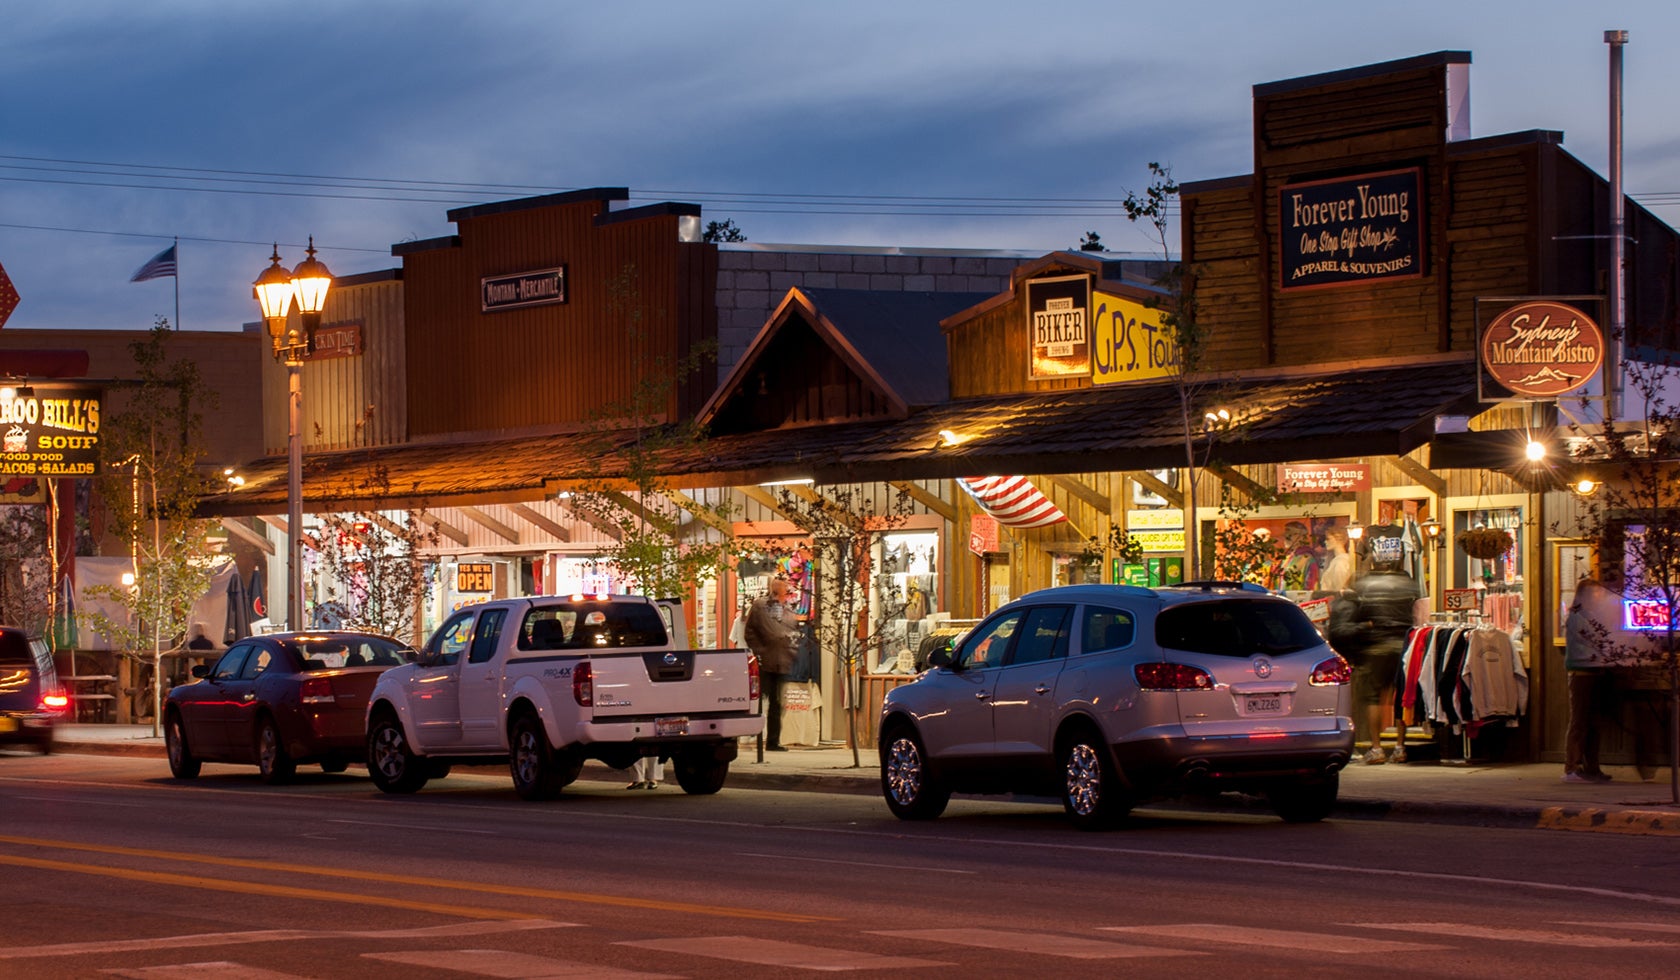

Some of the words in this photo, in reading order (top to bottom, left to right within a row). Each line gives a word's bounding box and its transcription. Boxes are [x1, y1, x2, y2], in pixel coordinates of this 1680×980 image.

[1292, 194, 1355, 228] Forever
[1357, 185, 1409, 223] Young
[1300, 232, 1318, 254] One
[1319, 230, 1338, 257] Stop
[1341, 227, 1359, 258] Gift
[1360, 224, 1381, 252] Shop
[1292, 261, 1339, 280] APPAREL
[1340, 262, 1349, 273] &
[1350, 255, 1412, 274] SOUVENIRS
[1037, 311, 1083, 344] BIKER
[1094, 302, 1140, 375] G.P.S.
[1505, 313, 1581, 358] Sydney's
[327, 333, 335, 348] IN
[1492, 340, 1554, 364] Mountain
[1557, 340, 1595, 363] Bistro
[42, 398, 99, 434] BILL'S
[32, 453, 64, 461] FOOD
[42, 462, 95, 474] SALADS
[1285, 468, 1328, 480] Forever
[1329, 467, 1364, 480] Young
[459, 564, 471, 573] YES
[472, 564, 491, 573] WE'RE
[458, 572, 492, 591] OPEN
[1447, 595, 1462, 608] $9
